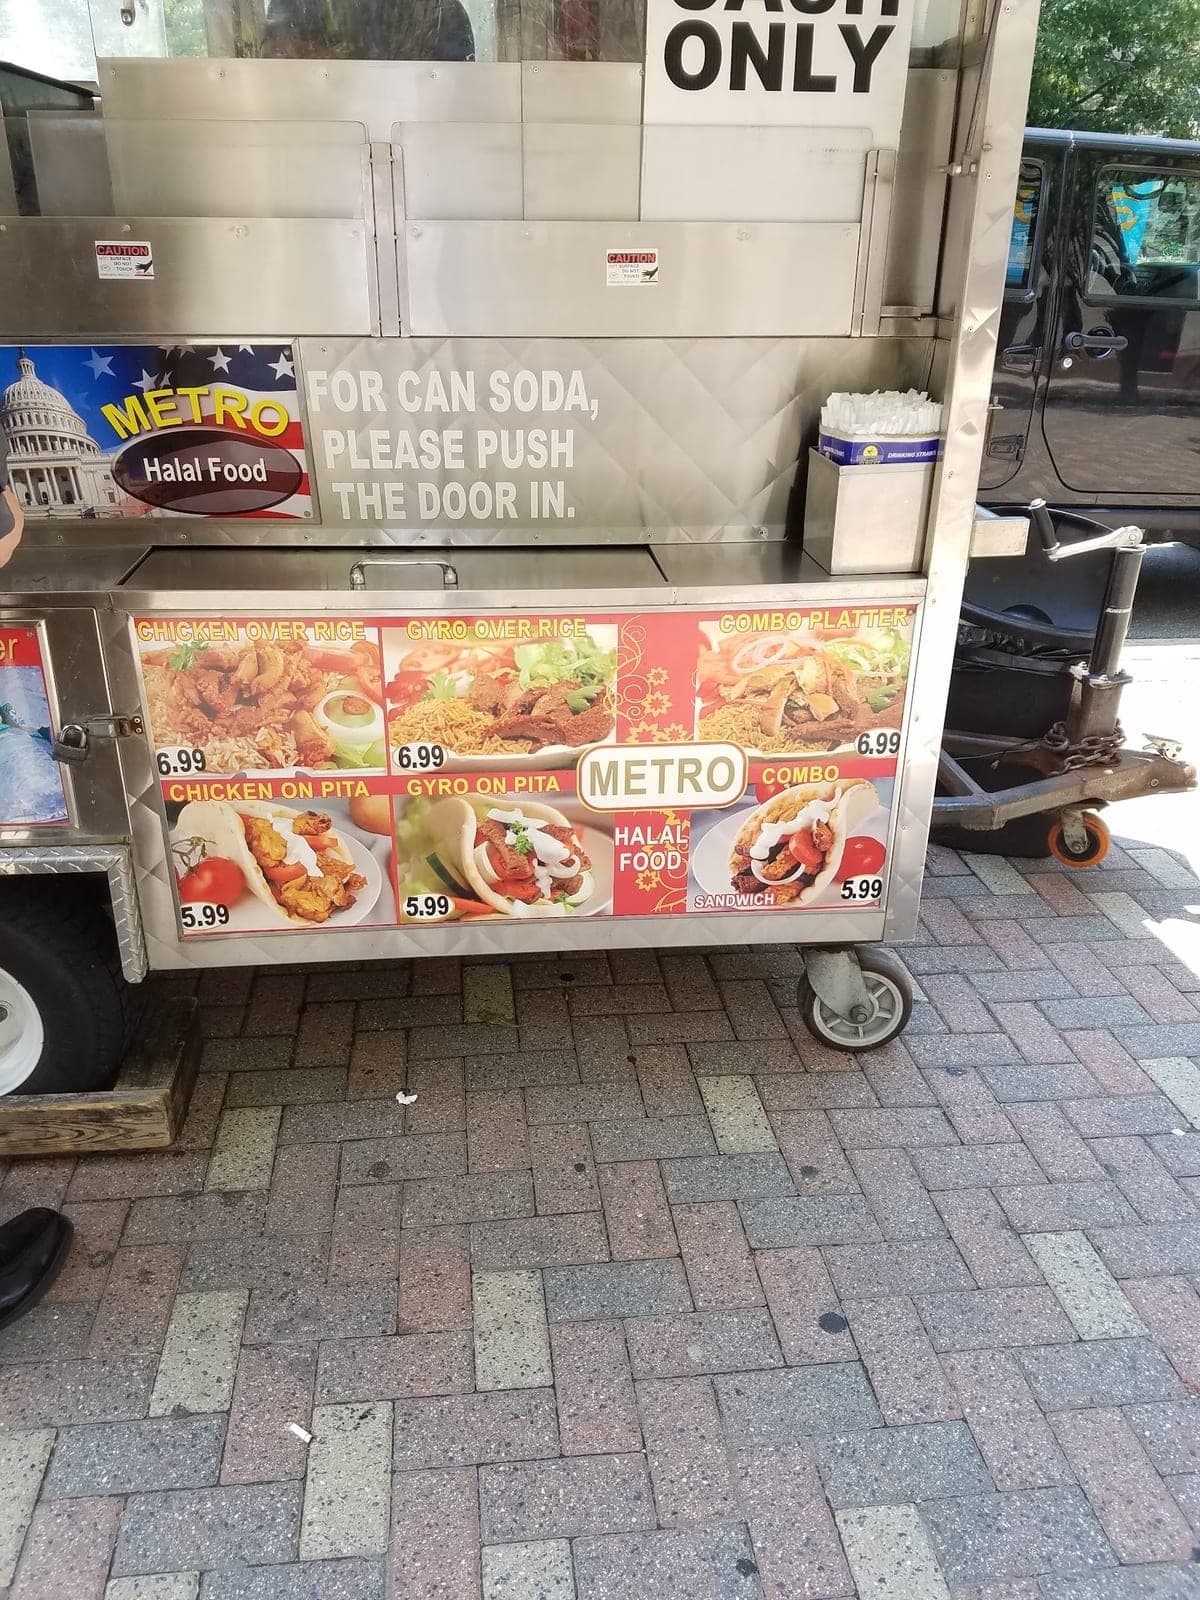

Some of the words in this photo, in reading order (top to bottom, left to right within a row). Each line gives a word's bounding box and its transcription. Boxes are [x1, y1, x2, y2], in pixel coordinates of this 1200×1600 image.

[664, 19, 896, 93] ONLY
[97, 245, 148, 256] CAUTION
[608, 253, 656, 263] CAUTION
[307, 370, 387, 412] FOR
[398, 370, 475, 412] CAN
[489, 370, 599, 421] SODA,
[101, 387, 289, 440] METRO
[323, 429, 465, 469] PLEASE
[477, 429, 574, 468] PUSH
[143, 457, 202, 482] Halal
[208, 457, 267, 482] Food
[332, 482, 406, 520] THE
[418, 481, 518, 520] DOOR
[530, 481, 575, 518] IN.
[136, 622, 238, 641] CHICKEN
[245, 622, 308, 641] OVER
[314, 621, 366, 640] RICE
[406, 620, 468, 640] GYRO
[474, 619, 531, 639] OVER
[538, 618, 587, 638] RICE
[719, 611, 802, 634] COMBO
[808, 607, 908, 630] PLATTER
[857, 732, 901, 755] 6.99
[157, 749, 207, 776] 6.99
[398, 744, 444, 769] 6.99
[406, 778, 469, 796] GYRO
[476, 777, 507, 795] ON
[514, 775, 560, 794] PITA
[589, 756, 735, 797] METRO
[761, 765, 840, 785] COMBO
[169, 781, 273, 802] CHICKEN
[280, 780, 314, 800] ON
[321, 780, 370, 798] PITA
[614, 825, 689, 847] HALAL
[619, 851, 682, 872] FOOD
[840, 879, 883, 900] 5.99
[406, 895, 449, 917] 5.99
[694, 893, 775, 909] SANDWICH
[181, 903, 230, 928] 5.99
